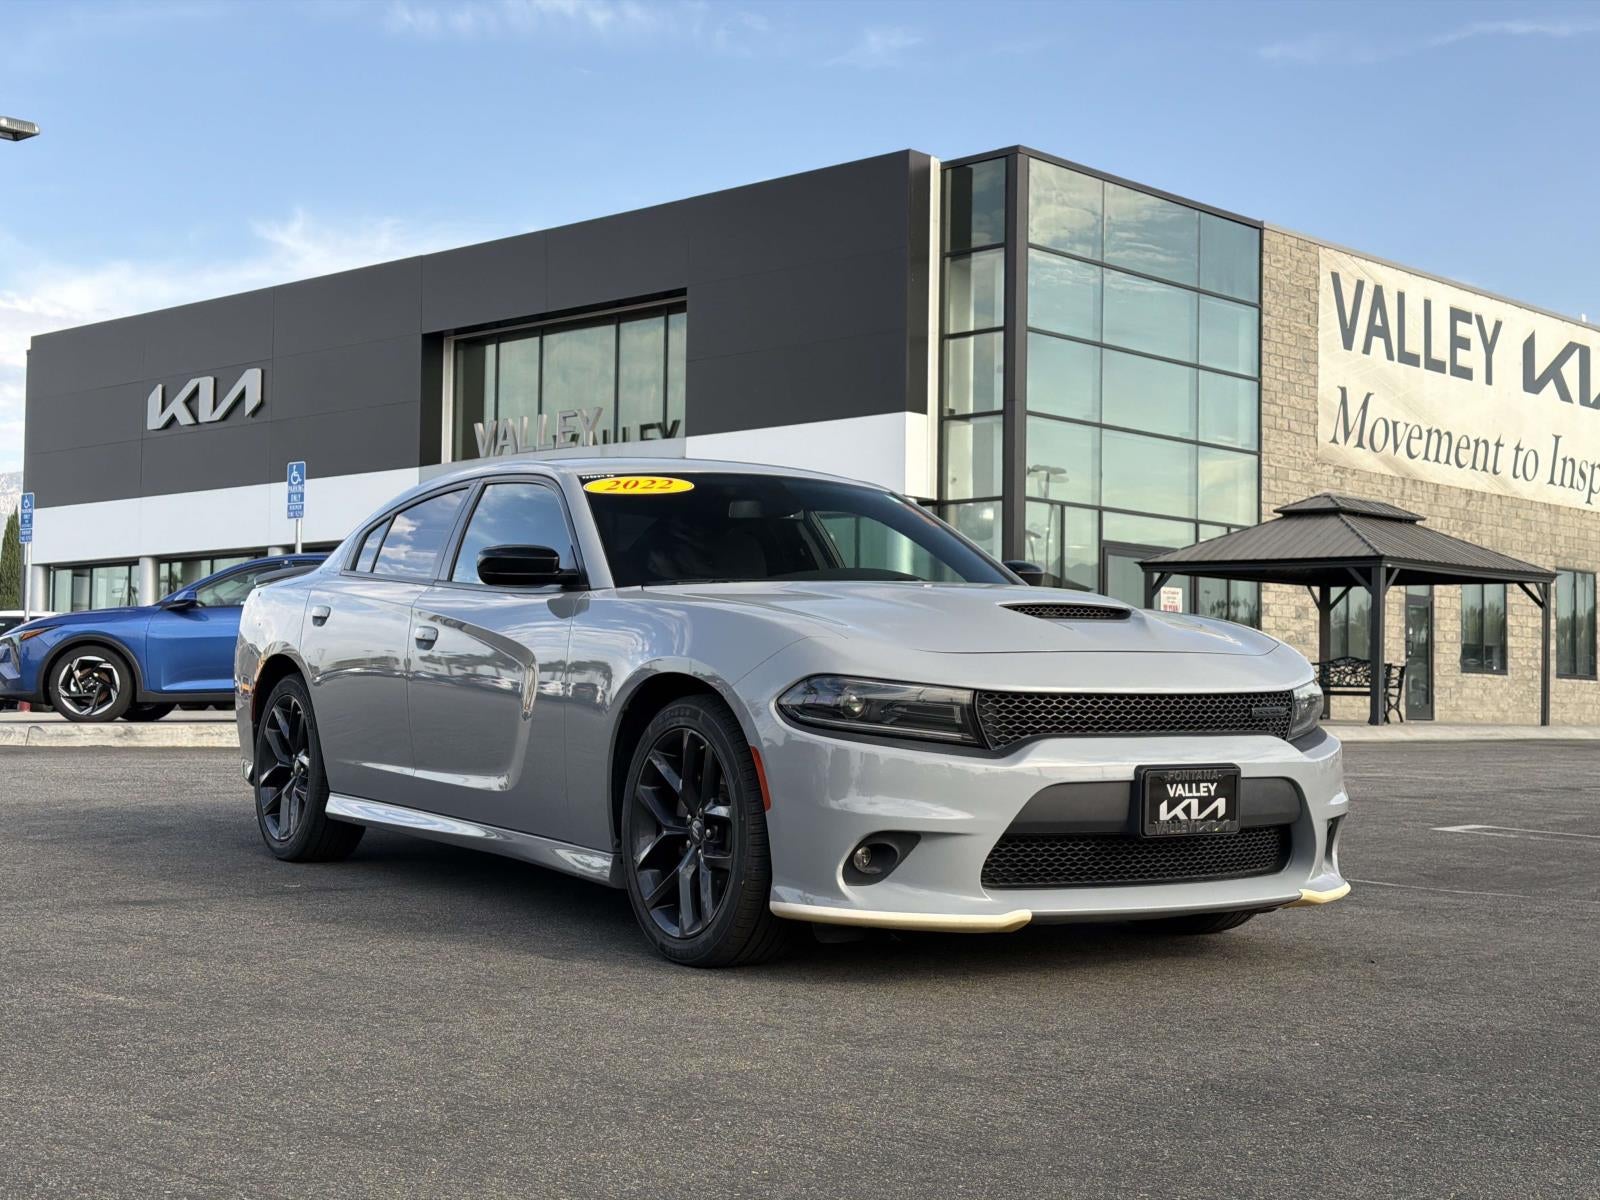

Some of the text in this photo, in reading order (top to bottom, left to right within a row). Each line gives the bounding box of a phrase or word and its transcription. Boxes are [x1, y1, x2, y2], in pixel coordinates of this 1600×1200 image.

[1331, 271, 1600, 410] VALLEY KI
[147, 367, 263, 431] KIA
[473, 407, 604, 458] VALLEY
[1329, 385, 1505, 476] Movement
[1511, 438, 1540, 483] to
[604, 479, 674, 490] 2022
[1159, 797, 1226, 821] KIA
[1166, 782, 1218, 797] VALLEY
